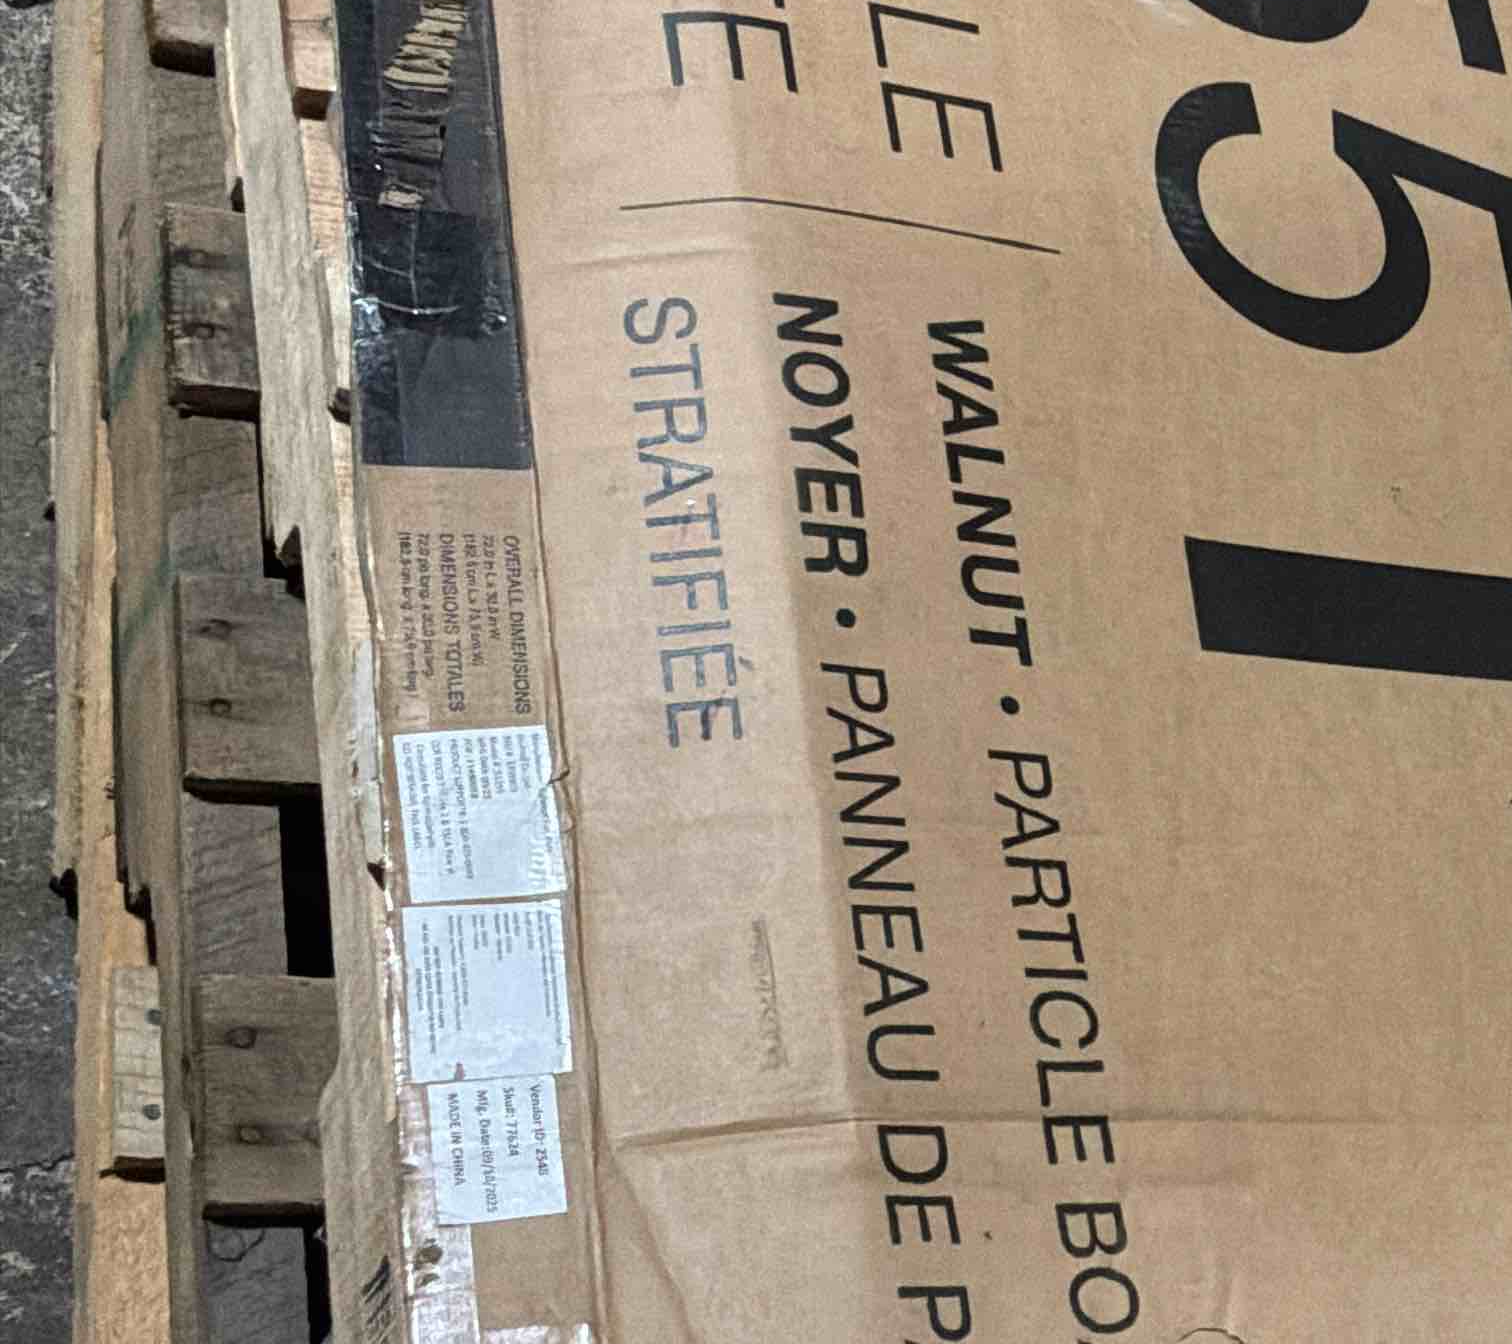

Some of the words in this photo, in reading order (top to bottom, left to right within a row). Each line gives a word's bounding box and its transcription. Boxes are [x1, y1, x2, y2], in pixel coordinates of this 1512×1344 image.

[772, 291, 870, 578] NOYER
[503, 535, 523, 607] OVERALL
[623, 295, 754, 749] STRATIFIÉE
[439, 533, 458, 635] DIMENSIONS
[445, 641, 464, 713] TOTALES
[510, 611, 531, 715] DIMENSIONS
[926, 317, 1033, 668] WALNUT
[987, 746, 1115, 1165] PARTICLE
[820, 660, 941, 1082] PANNEAU
[447, 1094, 461, 1128] MADE
[450, 1132, 461, 1144] IN
[451, 1148, 466, 1186] CHINA
[877, 1122, 962, 1247] DE
